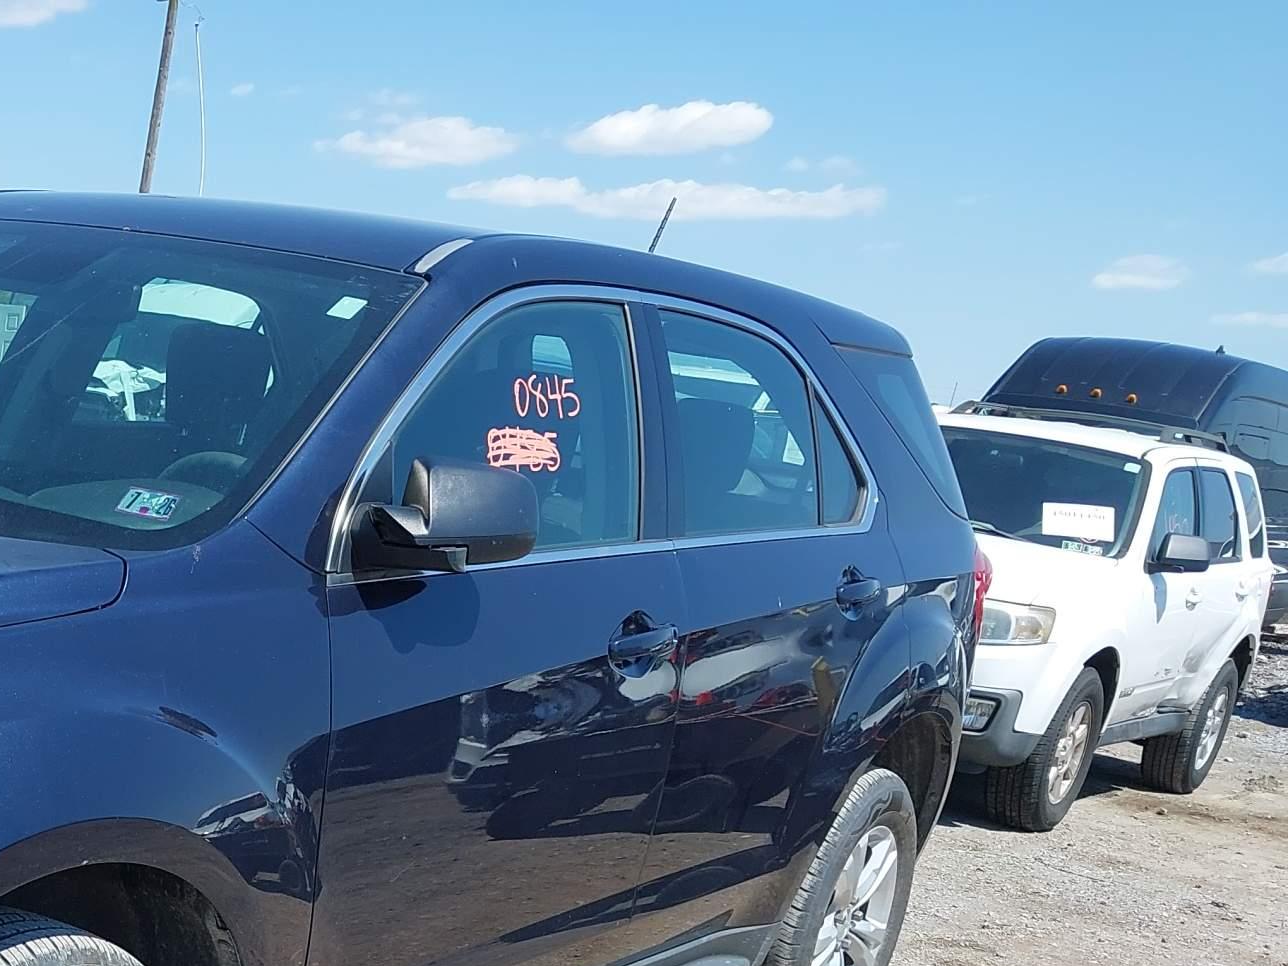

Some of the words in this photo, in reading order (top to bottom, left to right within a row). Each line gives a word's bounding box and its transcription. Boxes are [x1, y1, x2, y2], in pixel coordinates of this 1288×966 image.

[514, 374, 581, 419] 0845
[124, 491, 143, 509] 7
[155, 496, 178, 516] 26
